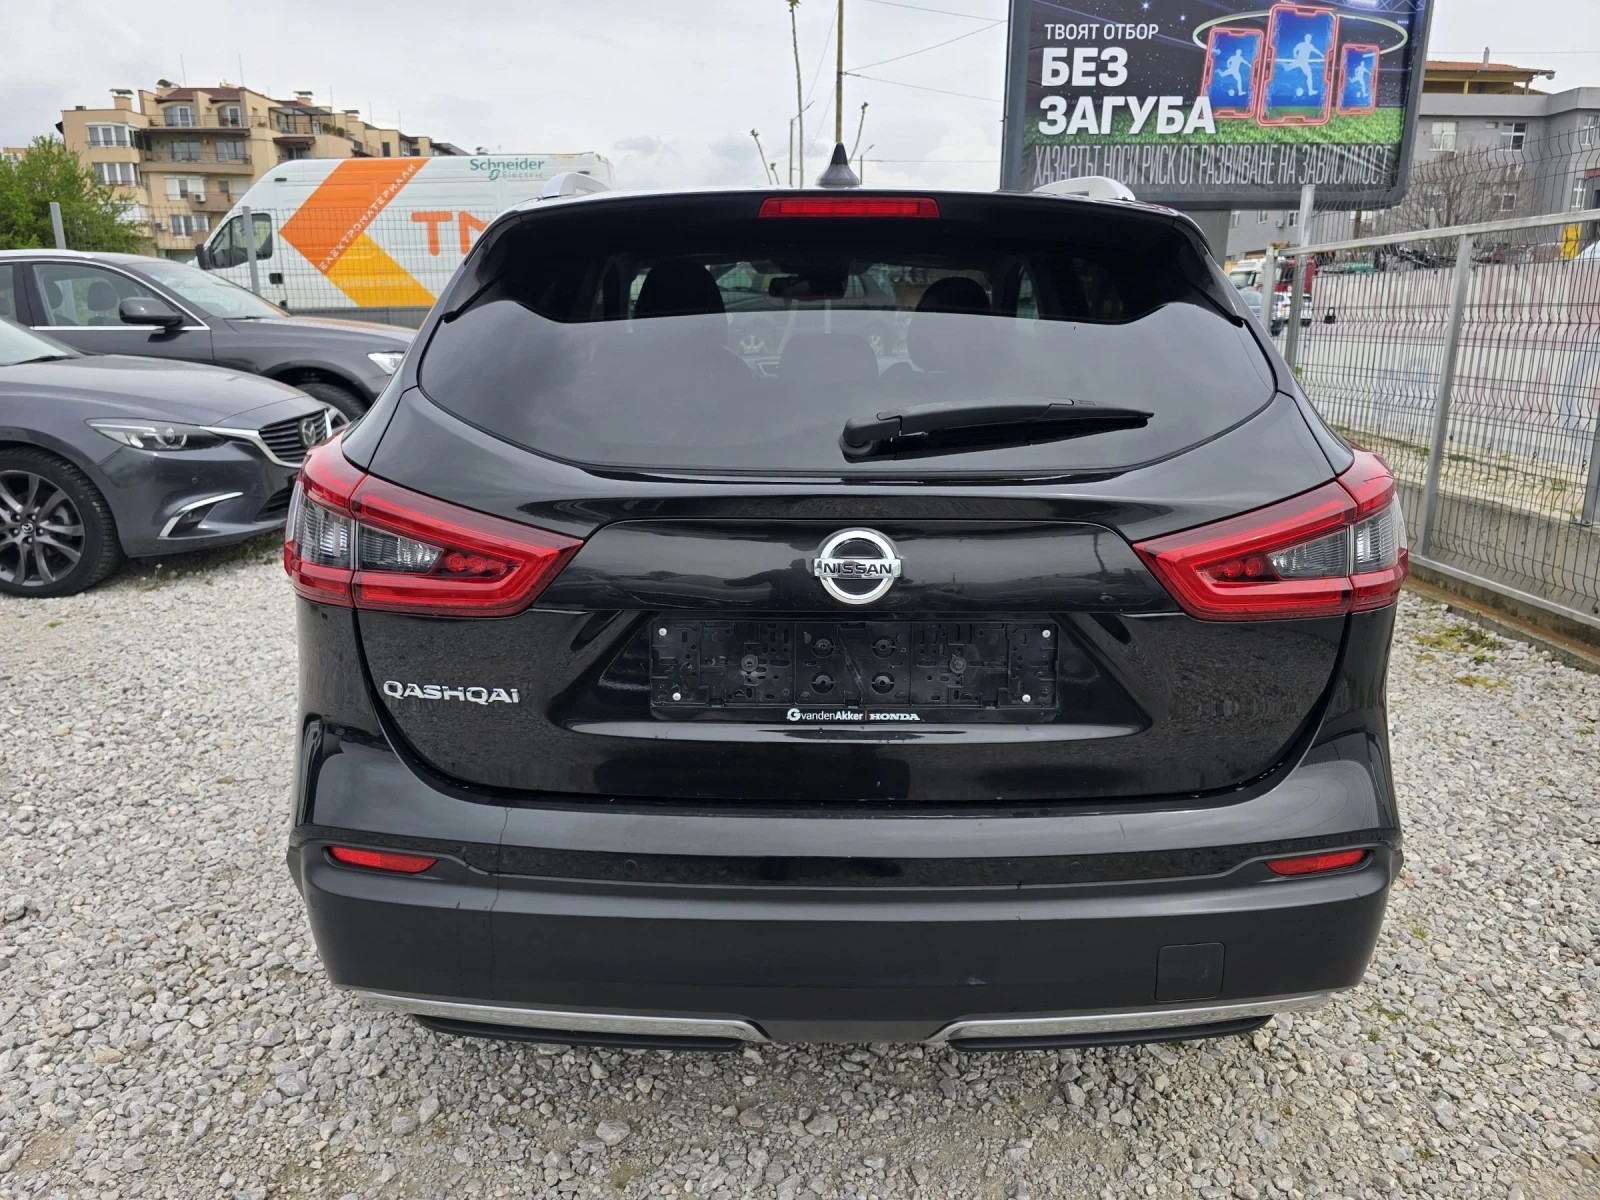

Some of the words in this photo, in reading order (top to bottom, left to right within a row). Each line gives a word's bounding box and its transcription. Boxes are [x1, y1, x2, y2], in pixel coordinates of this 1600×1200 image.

[1044, 24, 1100, 40] ТВОЯТ
[1103, 24, 1159, 40] ОТБОР
[1041, 47, 1129, 87] БЕЗ
[1038, 95, 1217, 135] ЗАГУБА
[470, 157, 545, 171] Schneider
[1103, 145, 1140, 185] НОСИ
[1141, 145, 1179, 185] РИСК
[1179, 145, 1200, 185] ОТ
[1199, 145, 1278, 185] РАЗВИВАНЕ
[1277, 145, 1297, 185] НА
[1299, 144, 1392, 185] ЗАВИСИМОСТ
[502, 170, 543, 179] Electric
[823, 562, 893, 575] NISSAN
[869, 713, 921, 721] HONDA
